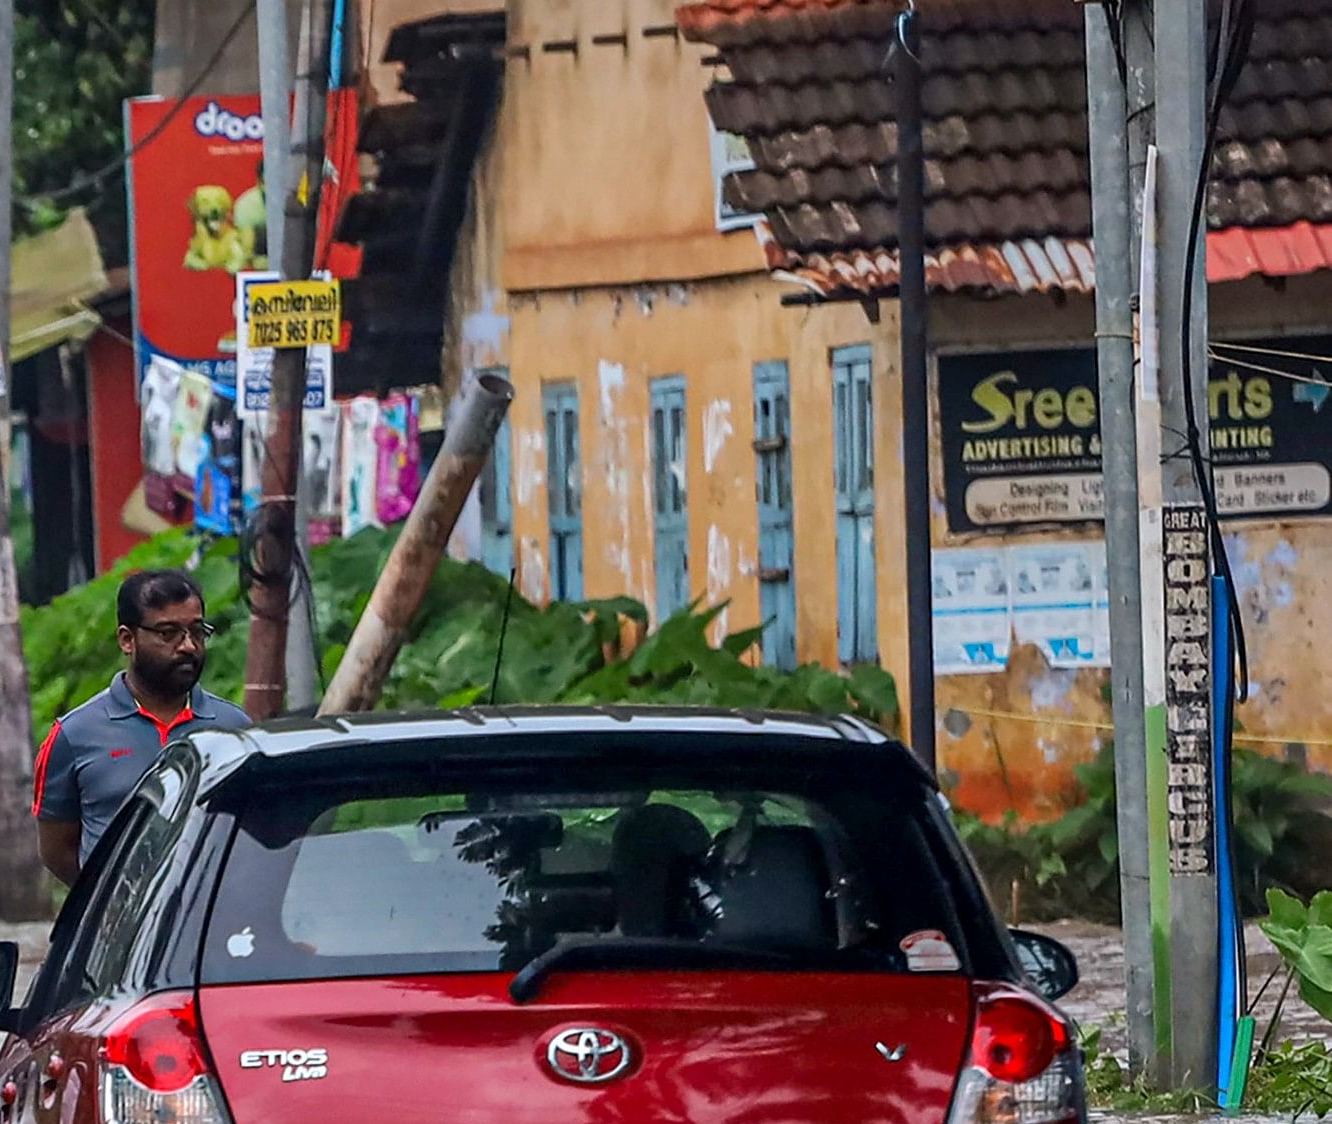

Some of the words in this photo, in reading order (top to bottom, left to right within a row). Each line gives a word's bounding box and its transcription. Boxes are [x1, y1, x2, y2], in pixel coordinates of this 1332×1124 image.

[194, 100, 264, 141] droo
[961, 370, 1097, 433] Sree
[1208, 371, 1273, 420] rts
[962, 434, 1083, 462] ADVERTISING
[1210, 426, 1273, 448] INTING
[1164, 511, 1206, 529] GREAT
[240, 1048, 328, 1068] ETIOS
